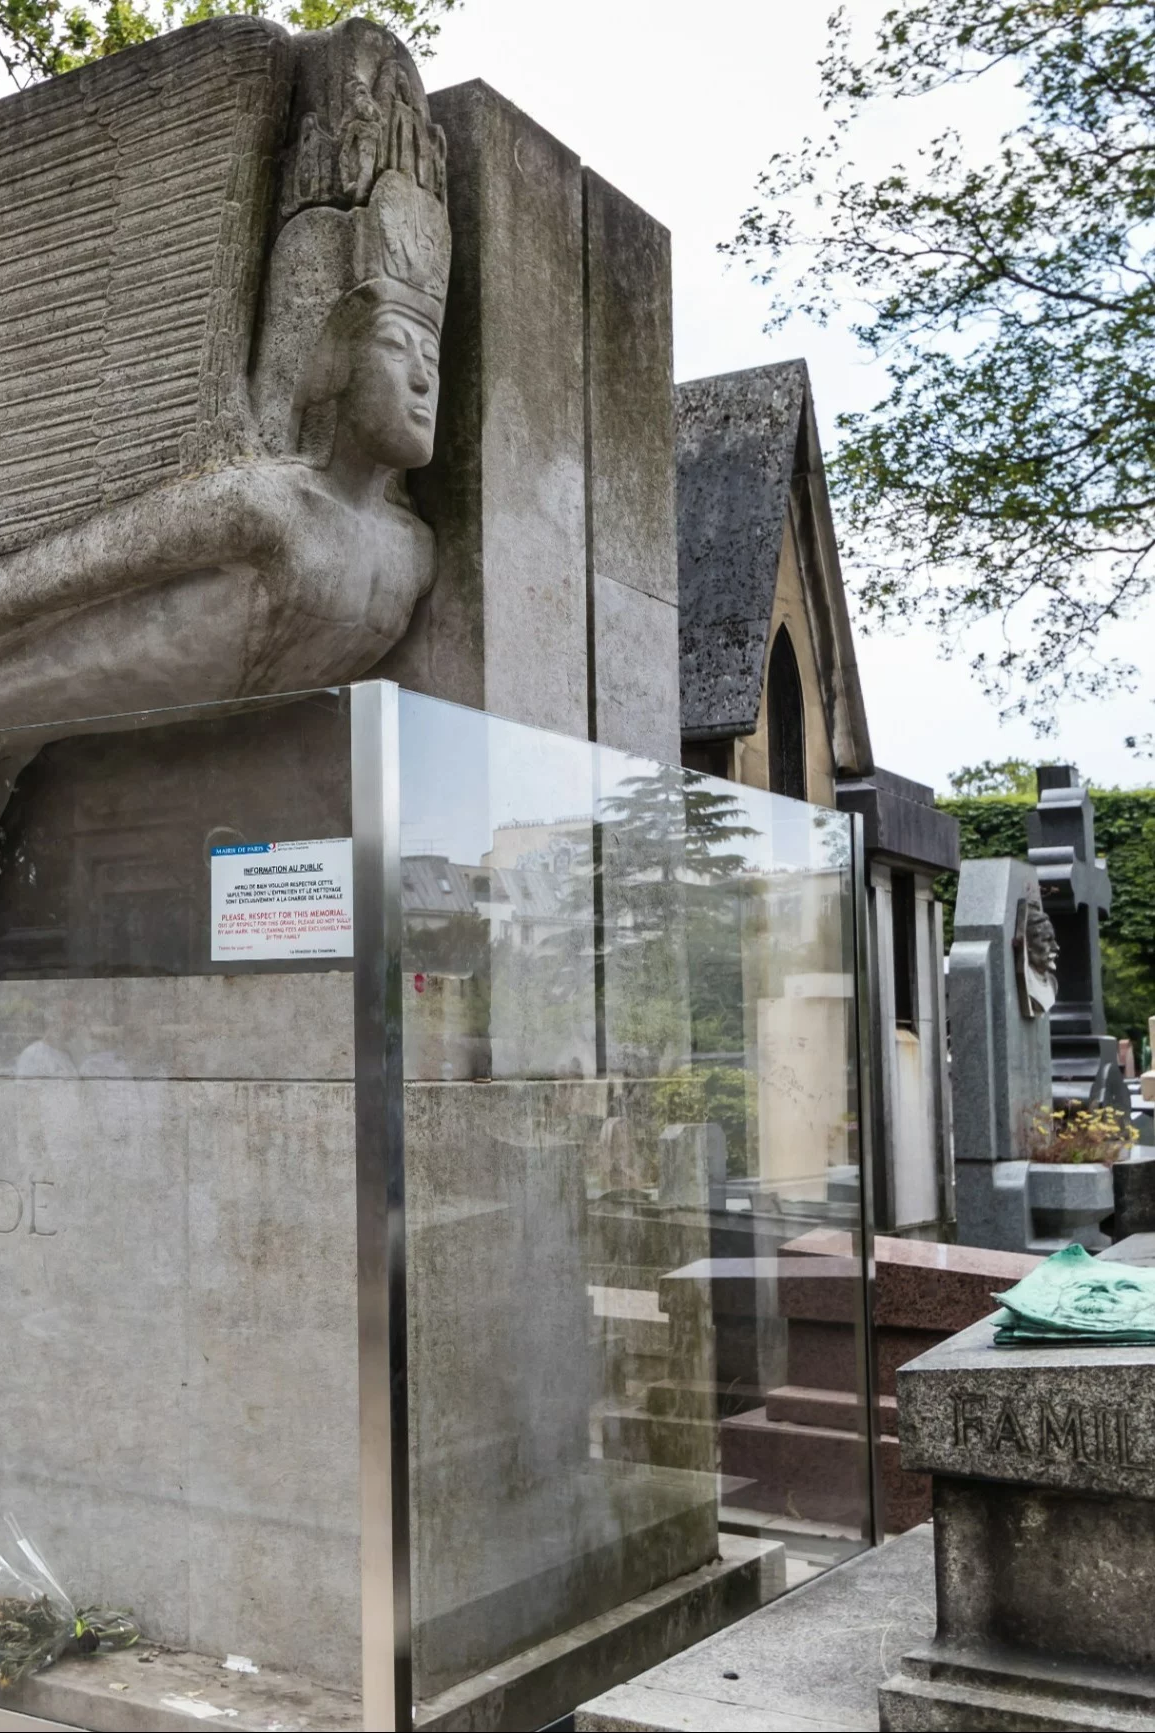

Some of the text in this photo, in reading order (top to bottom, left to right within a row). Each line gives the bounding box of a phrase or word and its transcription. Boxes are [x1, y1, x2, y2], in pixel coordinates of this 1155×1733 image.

[244, 865, 287, 875] INFORMATION
[300, 863, 323, 872] PUBLIC
[249, 912, 276, 920] RESPECT
[279, 911, 291, 919] FOR
[294, 910, 308, 918] THIS
